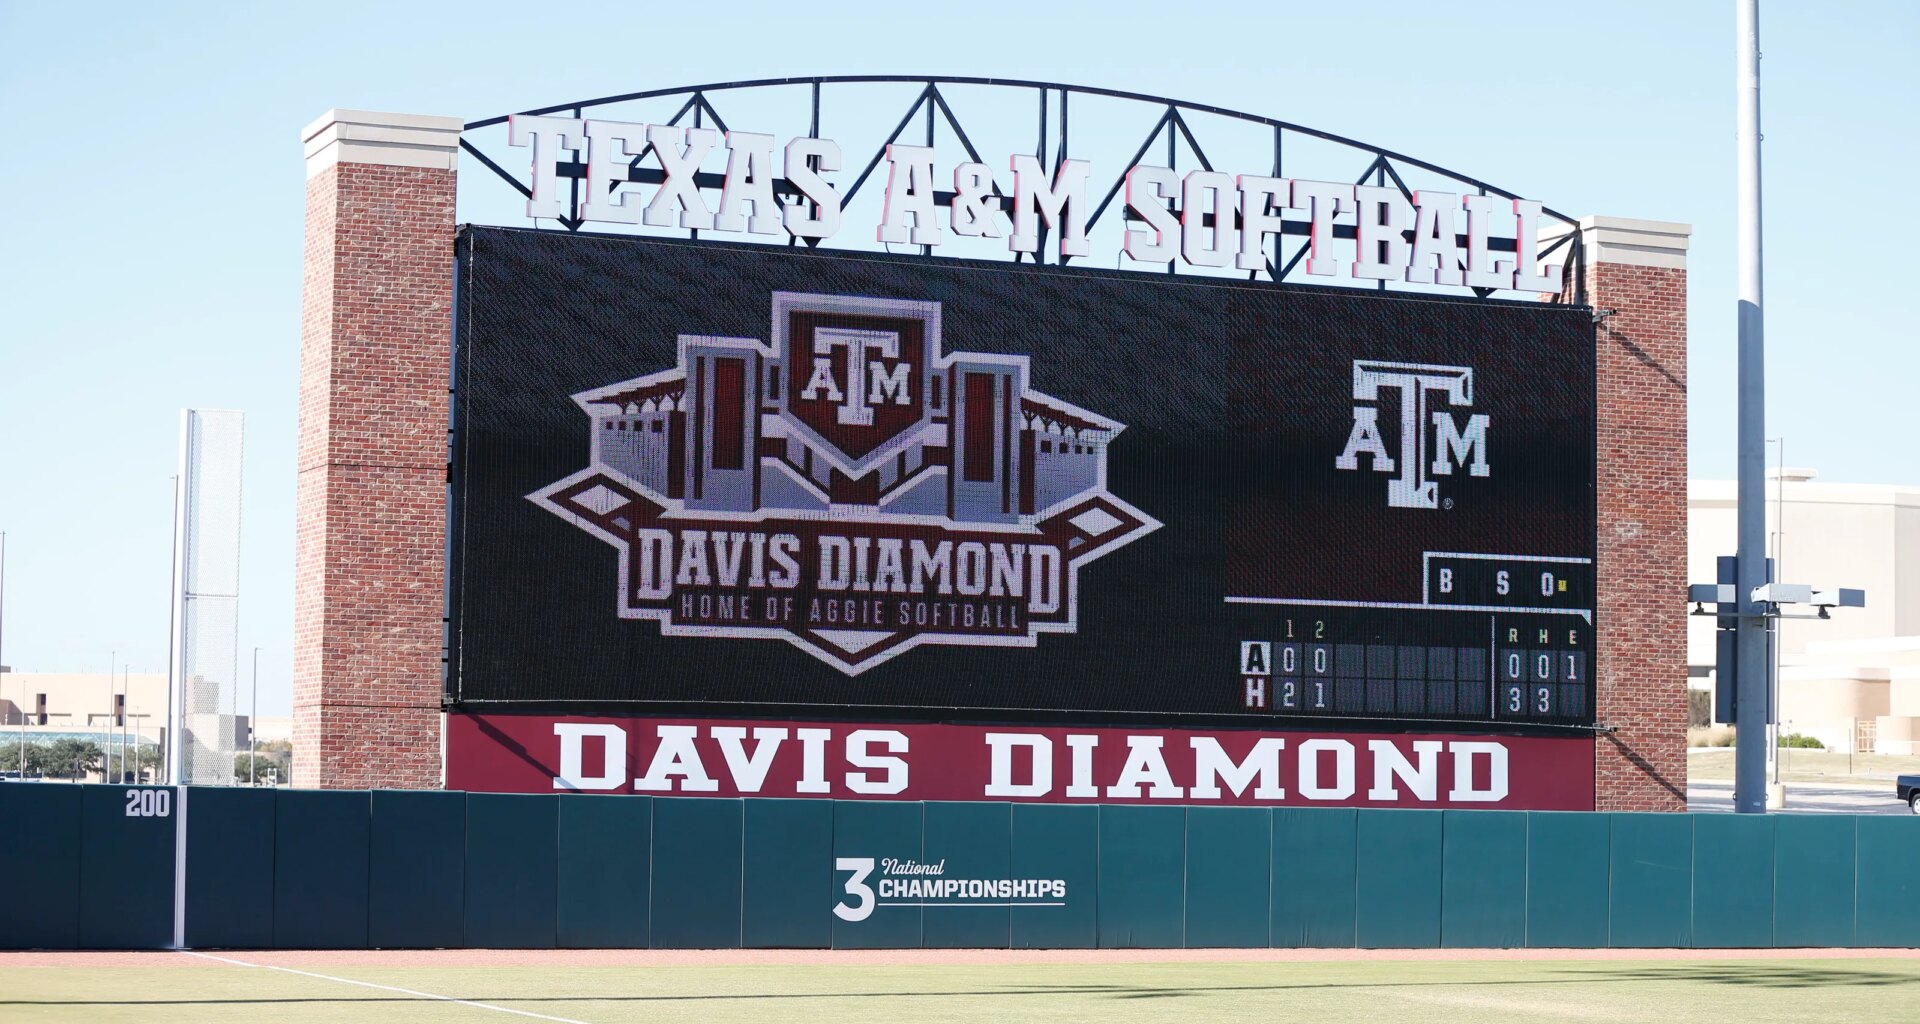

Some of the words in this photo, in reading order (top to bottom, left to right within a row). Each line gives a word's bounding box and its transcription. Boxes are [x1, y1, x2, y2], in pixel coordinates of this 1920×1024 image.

[509, 114, 842, 238] TEXAS
[877, 143, 1091, 257] A&M
[1124, 165, 1563, 293] SOFTBALL
[637, 528, 800, 600] DAVIS
[817, 535, 1061, 614] DIAMOND
[1439, 568, 1453, 593] B
[1496, 570, 1510, 595] S
[681, 593, 751, 621] HOME
[766, 597, 794, 621] OF
[809, 599, 884, 626] AGGIE
[899, 601, 1020, 629] SOFTBALL
[1286, 619, 1294, 638] 1
[1315, 620, 1324, 639] 2
[1508, 628, 1519, 643] R
[1539, 629, 1549, 644] H
[1569, 630, 1577, 645] E
[1246, 643, 1266, 673] A
[1283, 647, 1295, 672] 0
[1314, 648, 1326, 673] 0
[1508, 654, 1520, 679] 0
[1538, 654, 1549, 679] 0
[1567, 655, 1577, 680] 1
[1246, 678, 1265, 708] H
[1283, 682, 1295, 708] 2
[1315, 683, 1325, 708] 1
[1509, 687, 1521, 712] 3
[1538, 688, 1549, 713] 3
[553, 722, 909, 795] DAVIS
[984, 732, 1509, 802] DIAMOND
[126, 789, 170, 817] 200
[881, 857, 946, 876] National
[832, 857, 875, 922] 3
[879, 879, 1066, 898] CHAMPIONSHIPS
